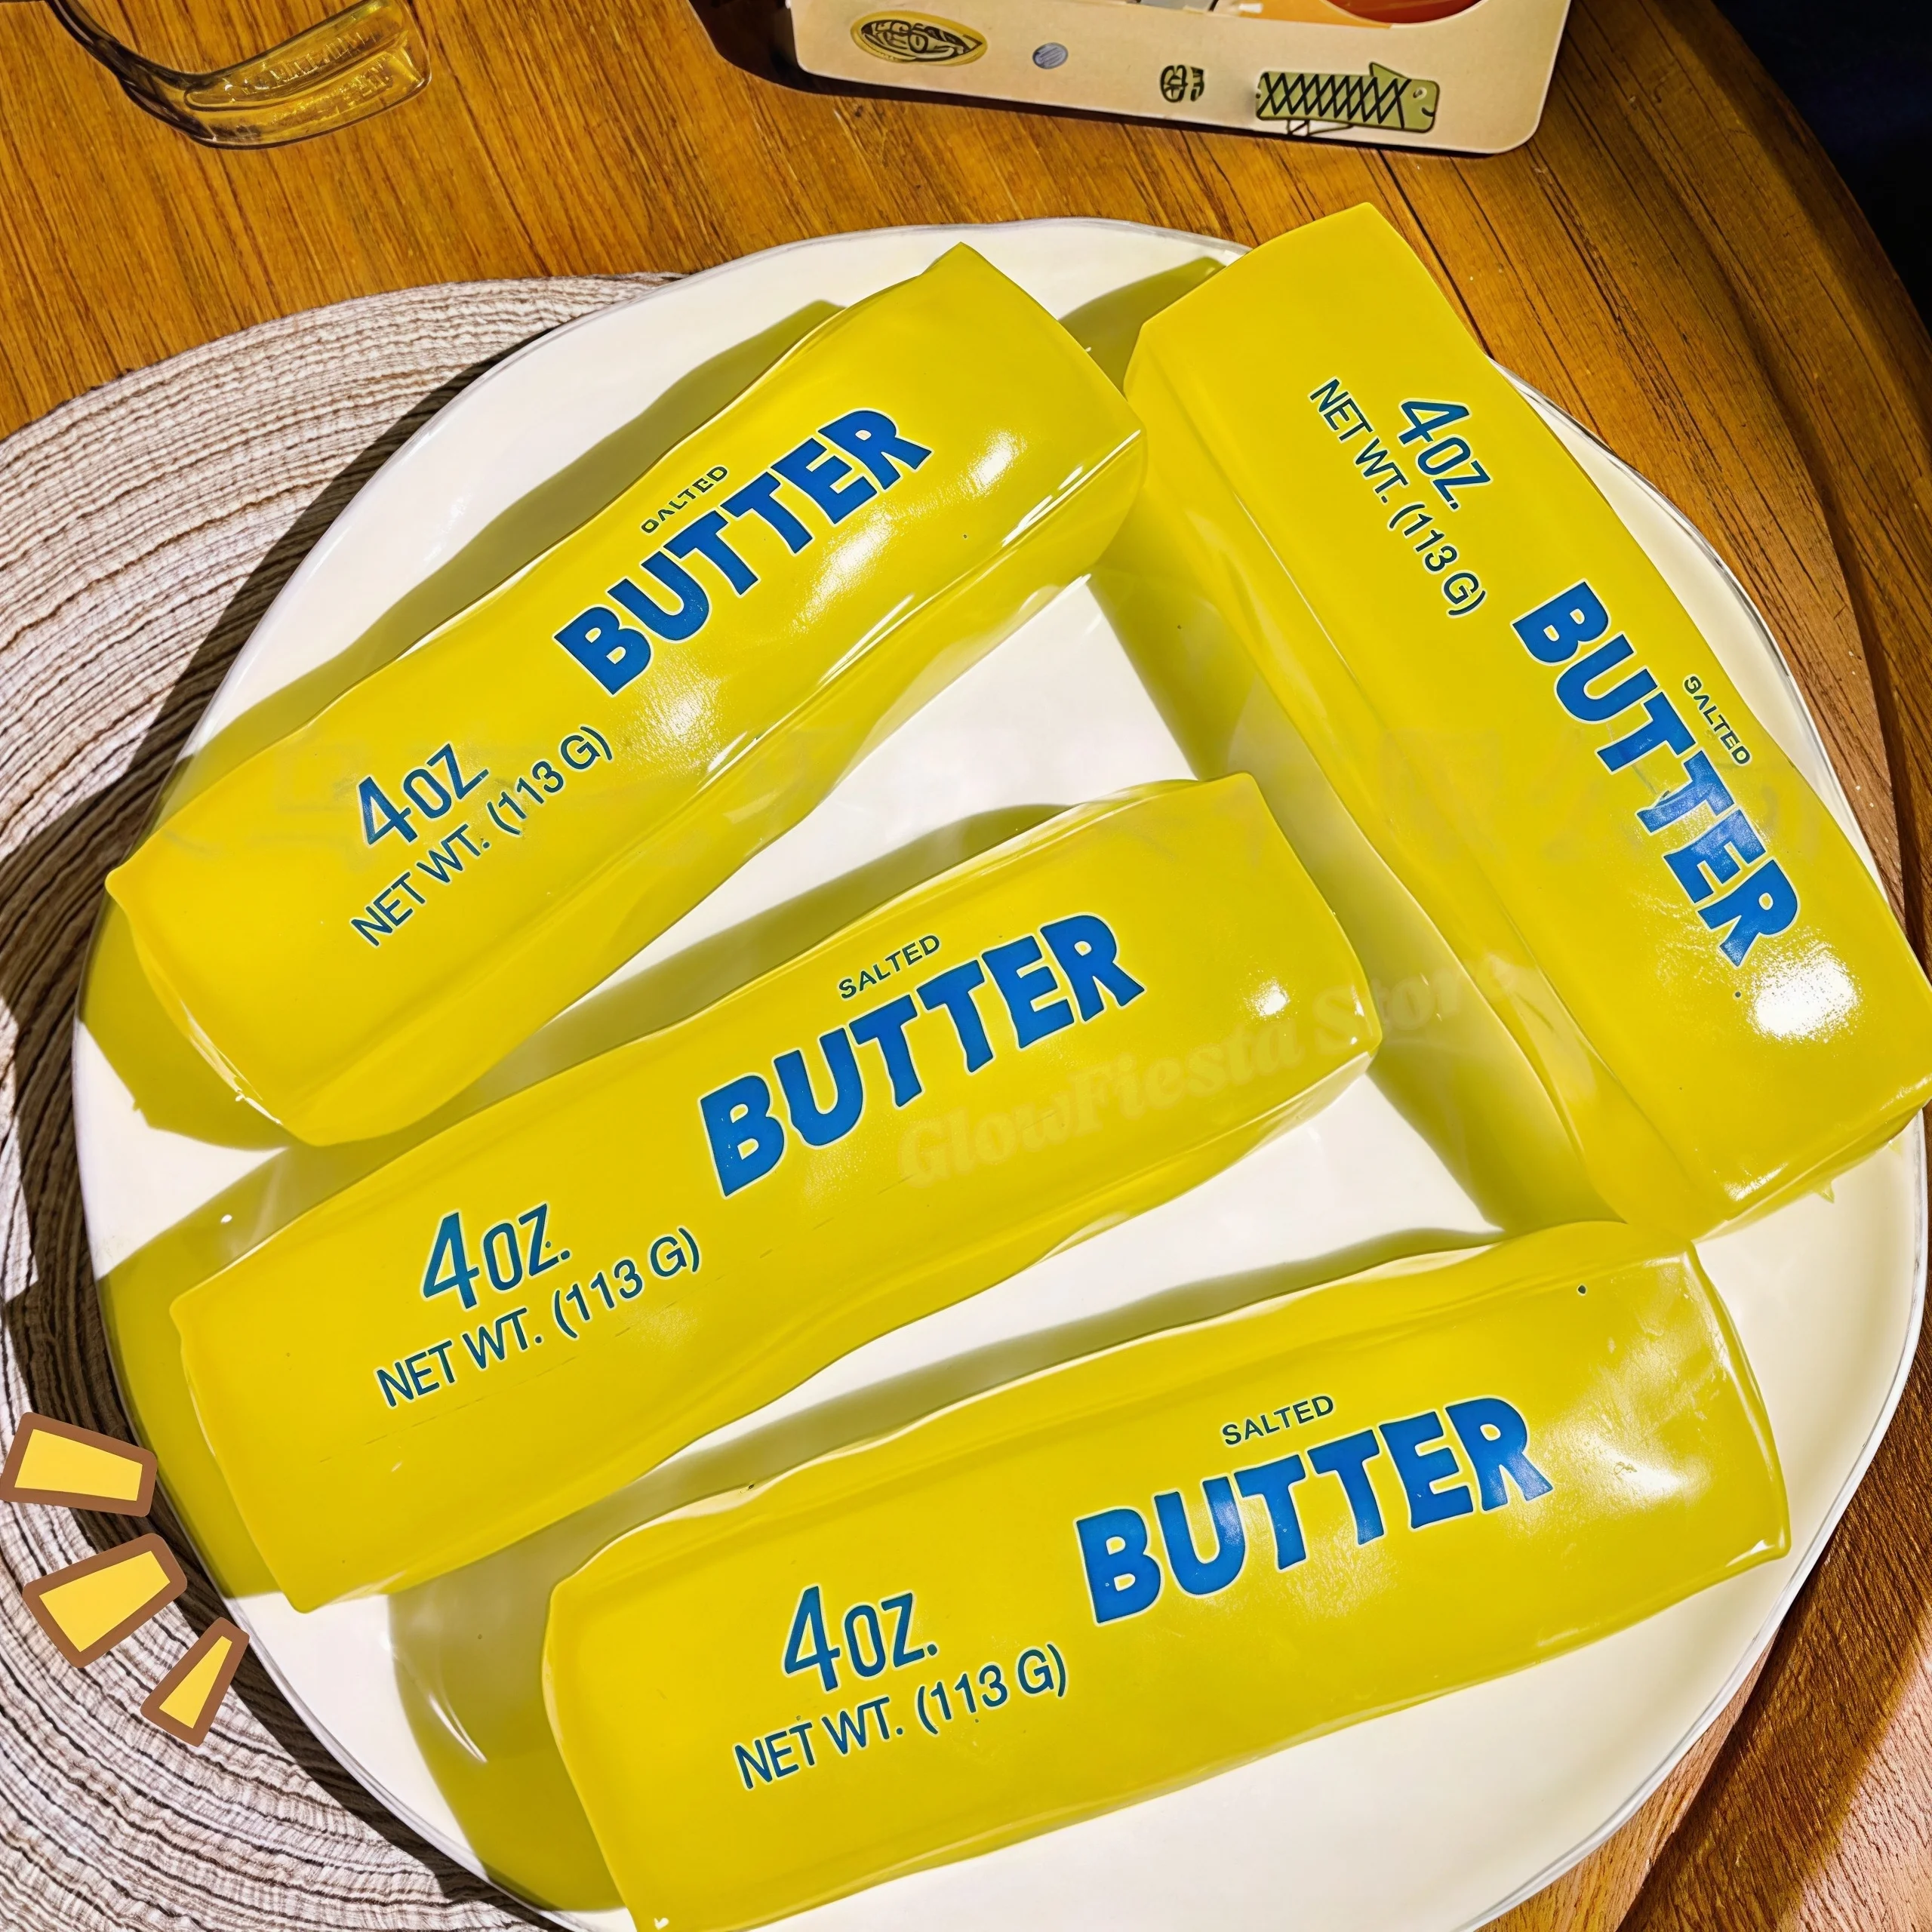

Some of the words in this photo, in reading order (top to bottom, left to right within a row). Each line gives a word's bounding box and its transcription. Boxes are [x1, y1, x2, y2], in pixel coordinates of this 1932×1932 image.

[553, 410, 933, 696] BUTTER
[1309, 378, 1374, 441] NET
[1355, 437, 1409, 504] WT.
[1389, 503, 1457, 572] (113
[1443, 572, 1486, 616] G)
[1512, 581, 1799, 968] BUTTER
[1684, 675, 1751, 765] SALTED
[351, 871, 426, 946] NET
[416, 823, 491, 884] WT.
[486, 761, 565, 835] (113
[560, 726, 613, 770] G)
[700, 915, 1146, 1197] BUTTER
[838, 935, 940, 1000] SALTED
[377, 1340, 456, 1407] NET
[462, 1307, 543, 1370] WT.
[554, 1259, 644, 1340] (113
[650, 1227, 700, 1278] G)
[1221, 1395, 1334, 1446] SALTED
[1075, 1397, 1554, 1625] BUTTER
[734, 1721, 816, 1789] NET
[821, 1696, 904, 1755] WT.
[917, 1664, 1008, 1735] (113
[1017, 1644, 1067, 1697] G)
